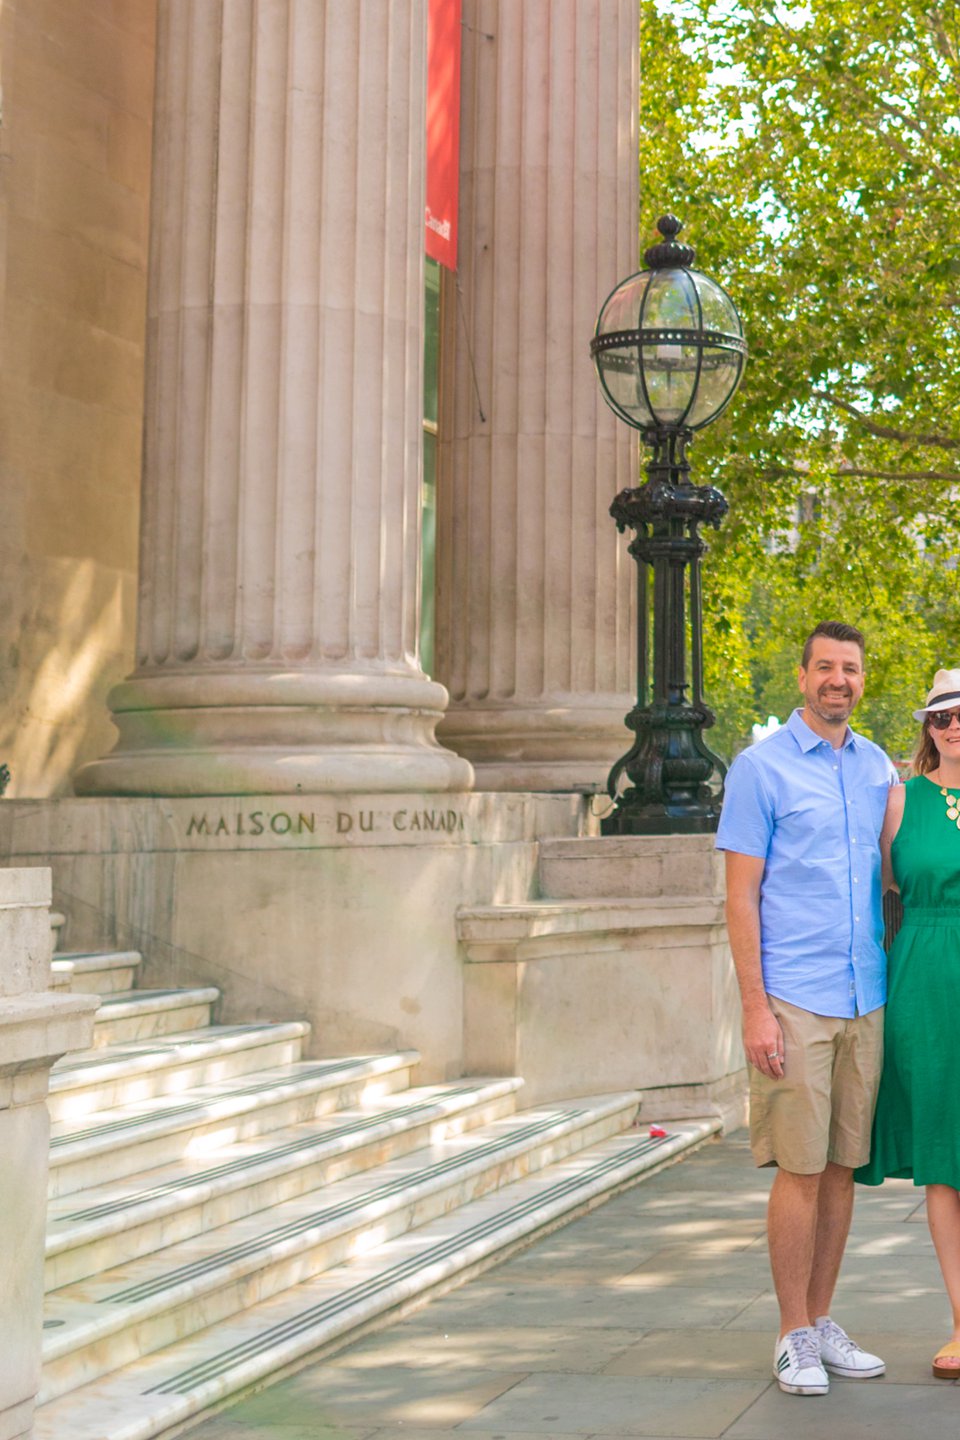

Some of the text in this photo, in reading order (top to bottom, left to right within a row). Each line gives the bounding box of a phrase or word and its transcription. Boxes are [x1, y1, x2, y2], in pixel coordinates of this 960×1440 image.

[186, 809, 464, 836] MAISON DU CANADA
